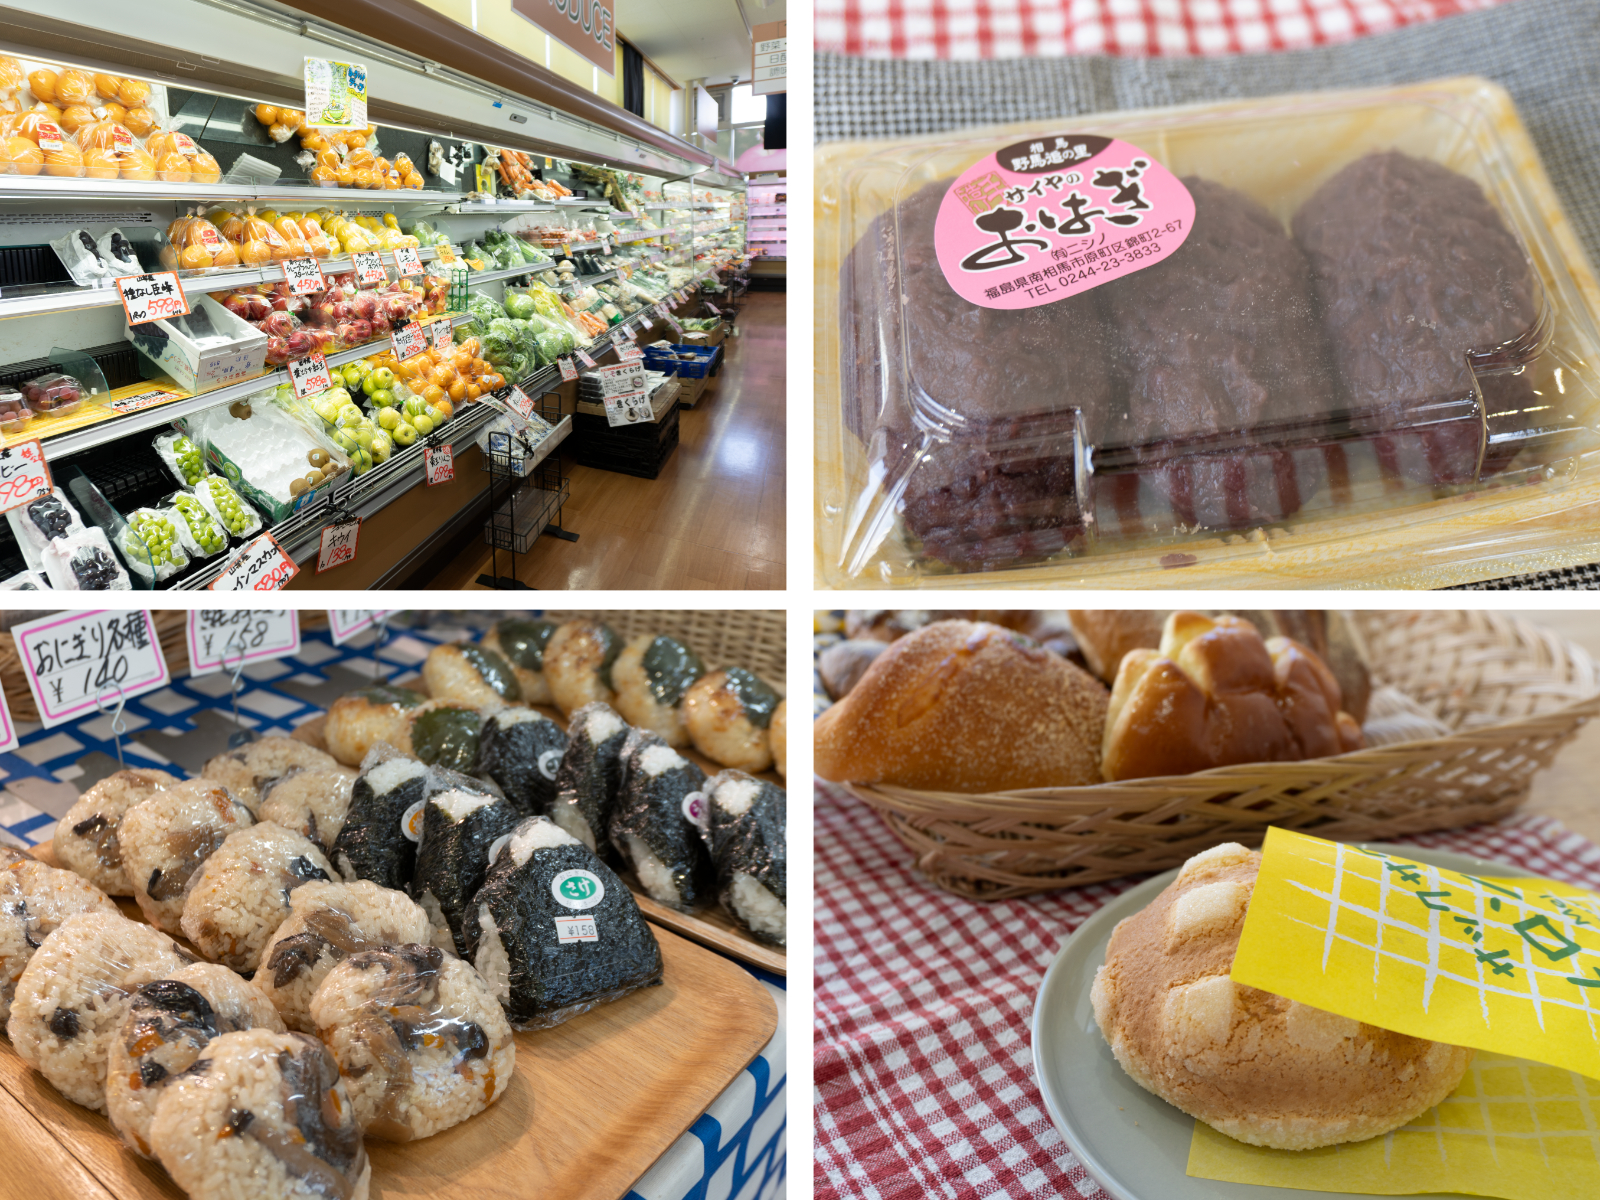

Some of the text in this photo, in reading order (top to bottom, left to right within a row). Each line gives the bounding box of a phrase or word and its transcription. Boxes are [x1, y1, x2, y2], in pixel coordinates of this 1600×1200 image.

[1010, 143, 1093, 172] 野馬追の里
[1029, 136, 1069, 154] 相馬
[1004, 173, 1082, 204] サイヤの
[962, 160, 1152, 270] おはぎ
[983, 219, 1183, 301] 福島県南相馬市原町区錦町2-67
[1023, 242, 1162, 299] TEL 0244-23-3833
[147, 297, 183, 316] 598円
[616, 394, 646, 409] きくらげ
[0, 475, 44, 505] 98円
[327, 530, 352, 548] キウイ
[34, 610, 151, 676] おにぎり各種
[565, 878, 591, 897] さけ
[567, 924, 595, 936] ¥158
